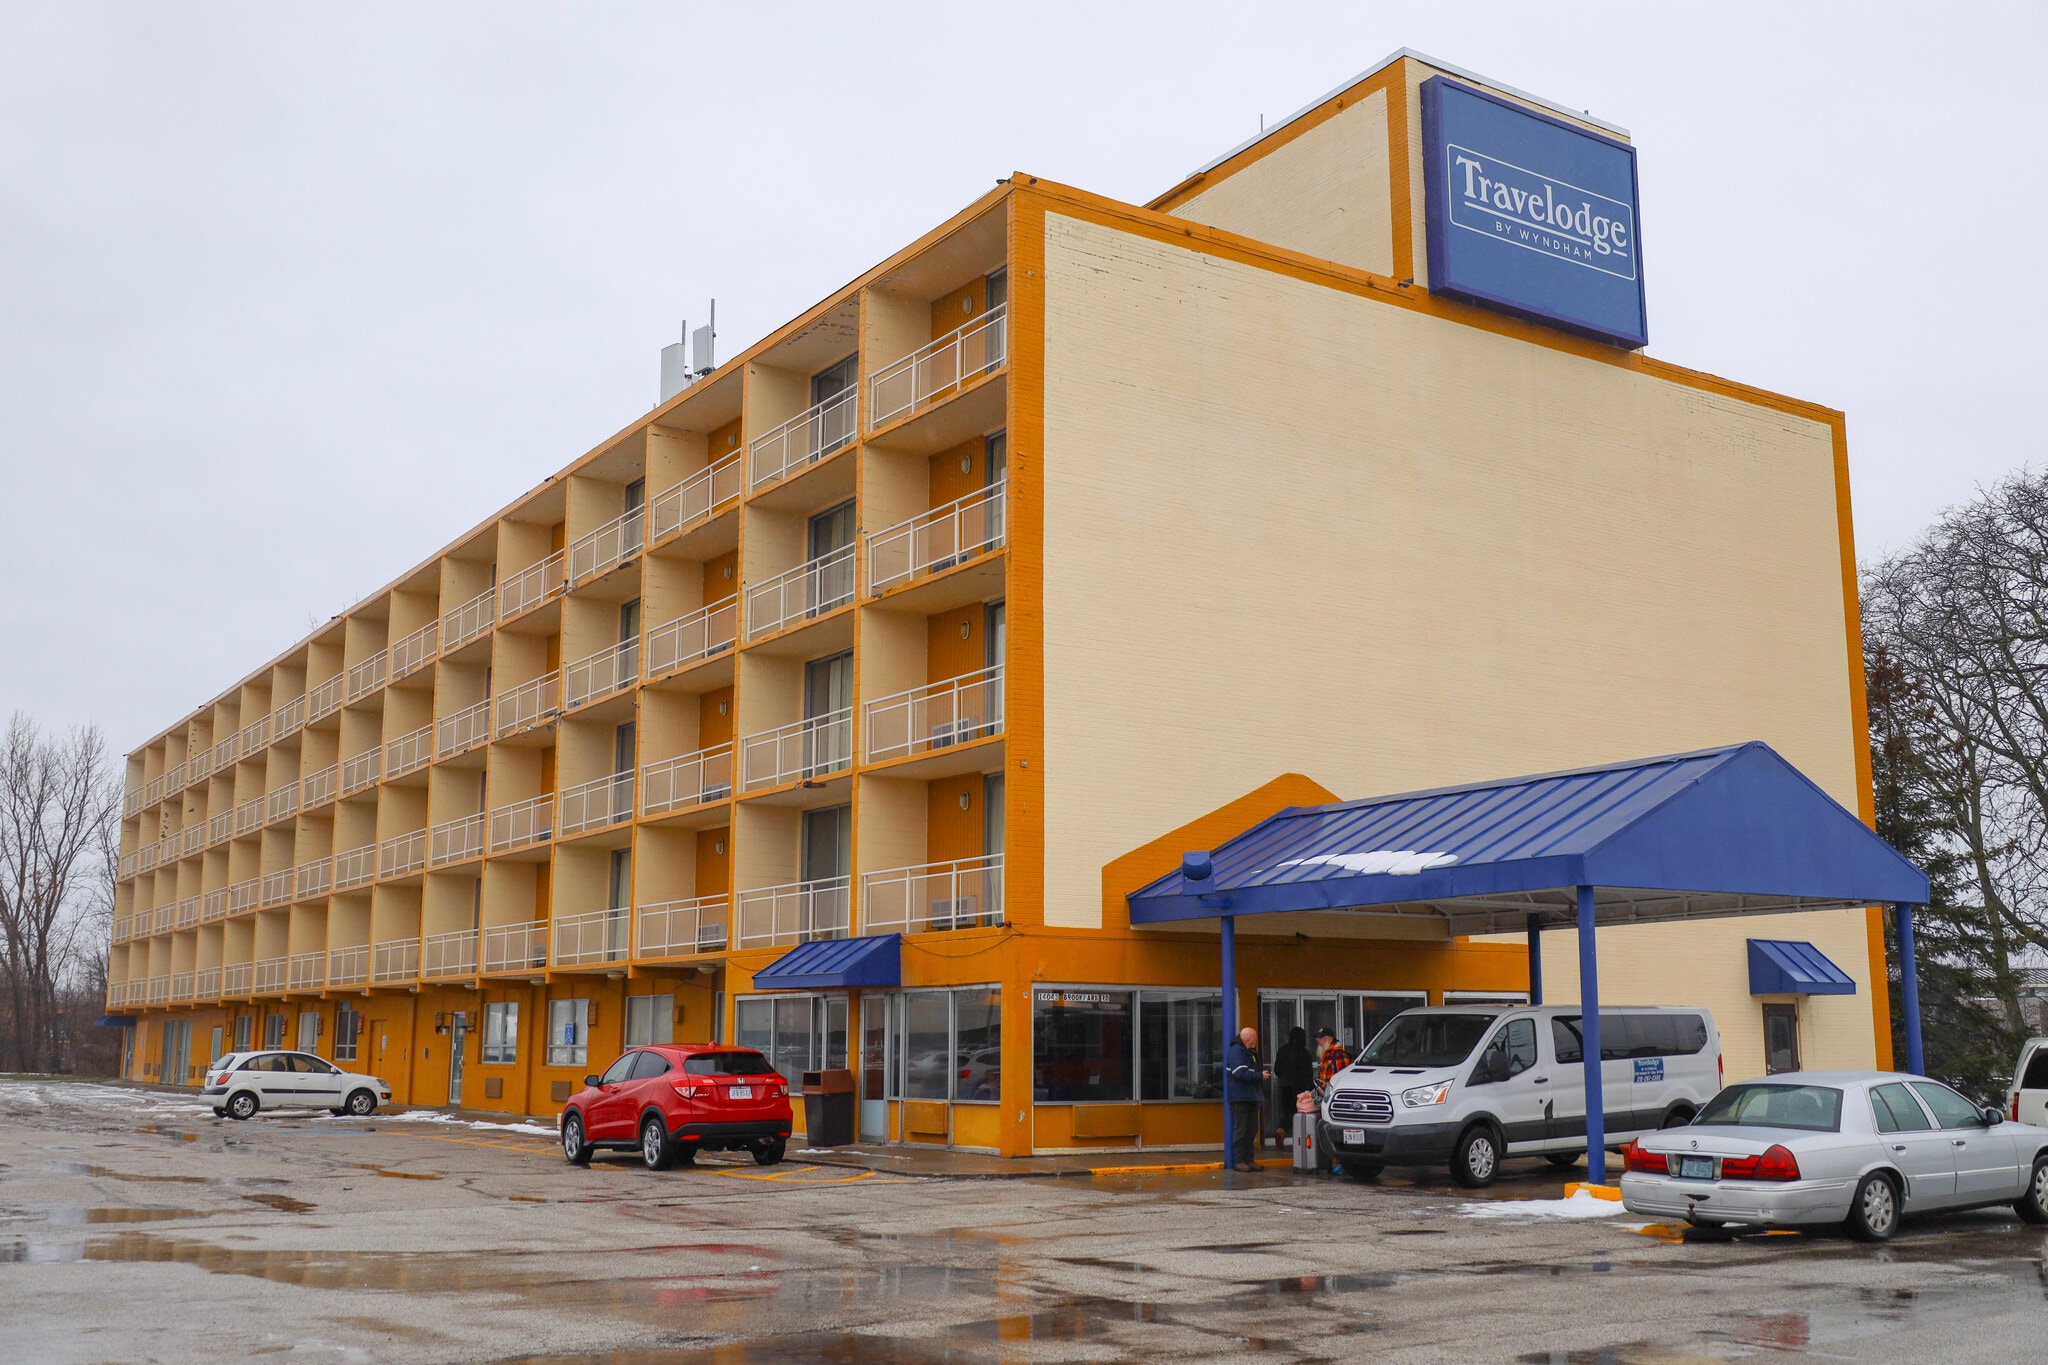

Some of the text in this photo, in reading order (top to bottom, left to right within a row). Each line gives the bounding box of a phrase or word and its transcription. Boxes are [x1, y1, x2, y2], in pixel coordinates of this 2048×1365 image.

[1455, 154, 1628, 256] Travelodge
[1495, 221, 1593, 260] BY WYNDHAM
